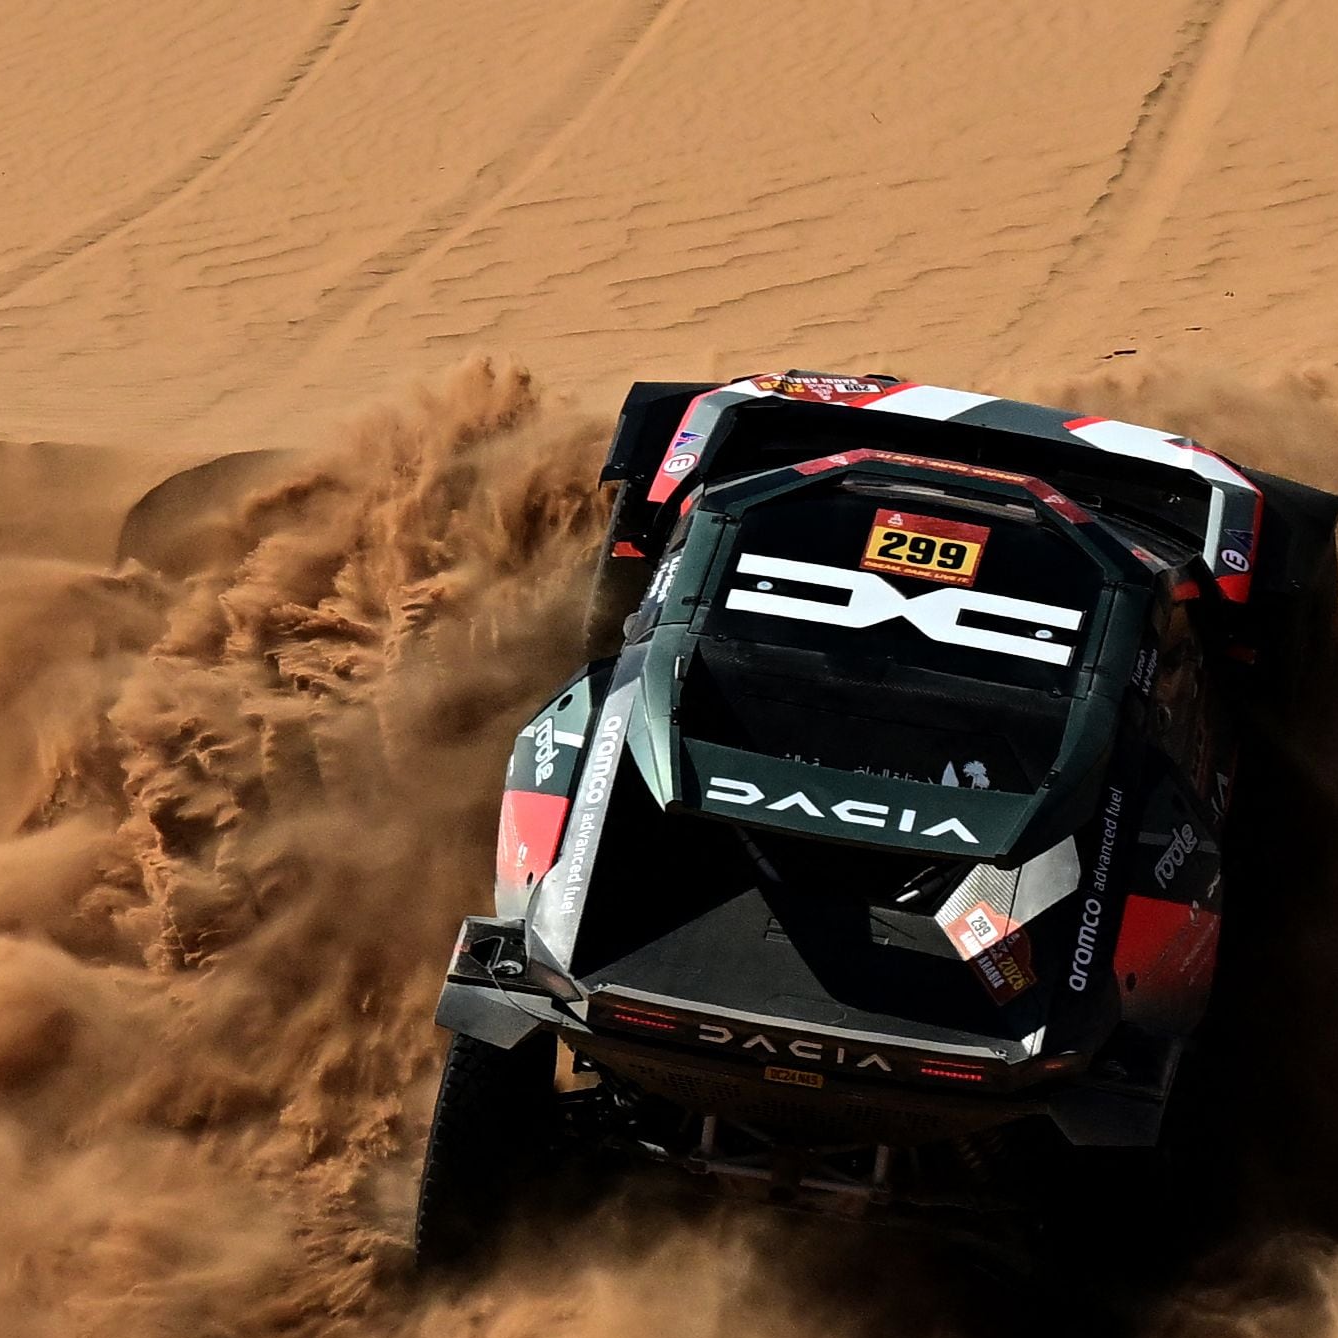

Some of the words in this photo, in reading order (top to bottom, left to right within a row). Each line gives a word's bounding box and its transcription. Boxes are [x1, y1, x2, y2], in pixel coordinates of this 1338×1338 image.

[845, 384, 871, 392] 299
[877, 531, 967, 570] 299
[585, 715, 622, 803] aramco
[706, 777, 980, 844] DACIA
[567, 810, 595, 884] advanced
[560, 885, 581, 914] fuel
[1068, 898, 1102, 992] aramco
[1094, 817, 1117, 891] advanced
[1107, 786, 1124, 817] fuel
[970, 916, 992, 937] 299
[977, 955, 1005, 989] ARABIA
[698, 1023, 892, 1072] DACIA
